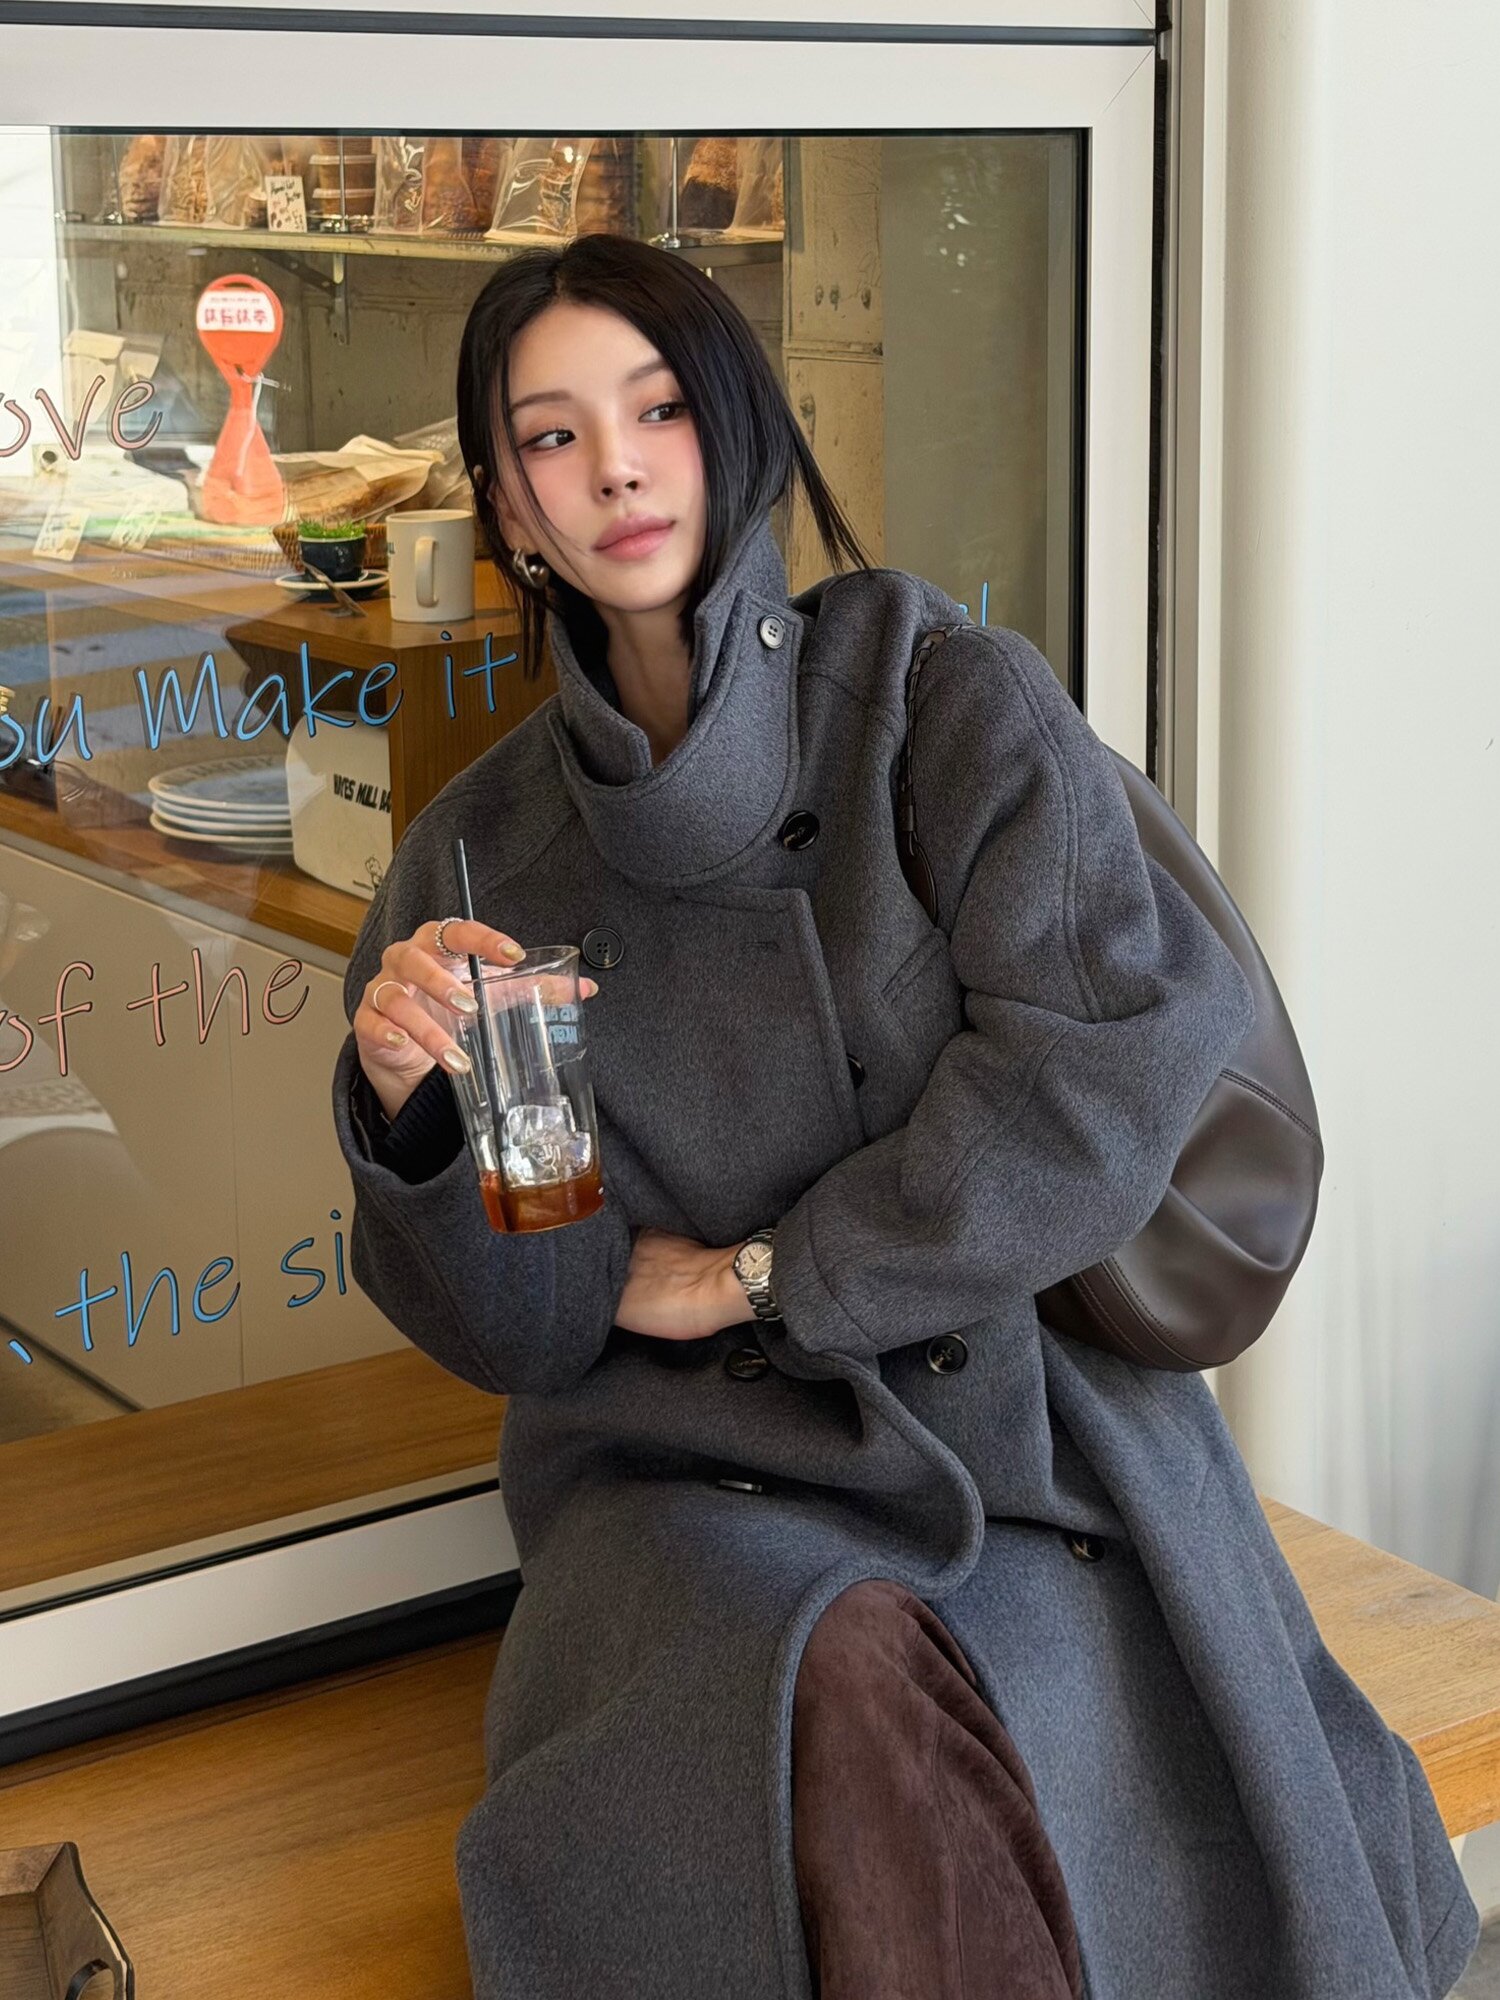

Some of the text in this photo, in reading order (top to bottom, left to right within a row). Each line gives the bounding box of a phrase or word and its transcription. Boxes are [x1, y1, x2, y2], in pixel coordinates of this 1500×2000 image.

[135, 641, 404, 752] Make
[440, 630, 519, 720] it
[126, 947, 310, 1047] the
[55, 1251, 241, 1352] the
